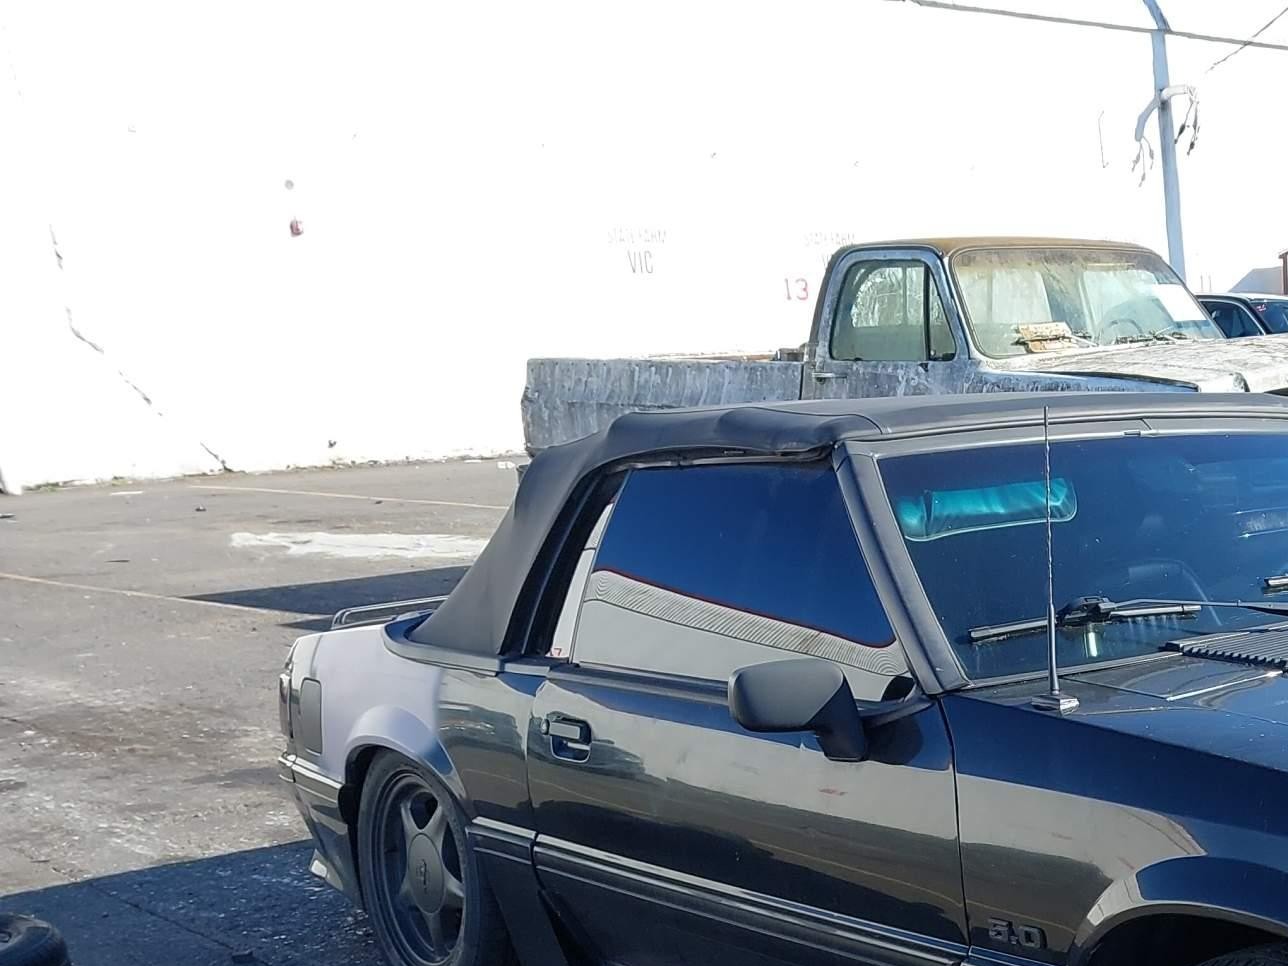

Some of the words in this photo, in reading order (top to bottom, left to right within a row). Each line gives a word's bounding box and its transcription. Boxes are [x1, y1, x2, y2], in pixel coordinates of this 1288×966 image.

[627, 249, 654, 274] VIC
[784, 278, 809, 301] 13
[988, 918, 1042, 948] 5.0
